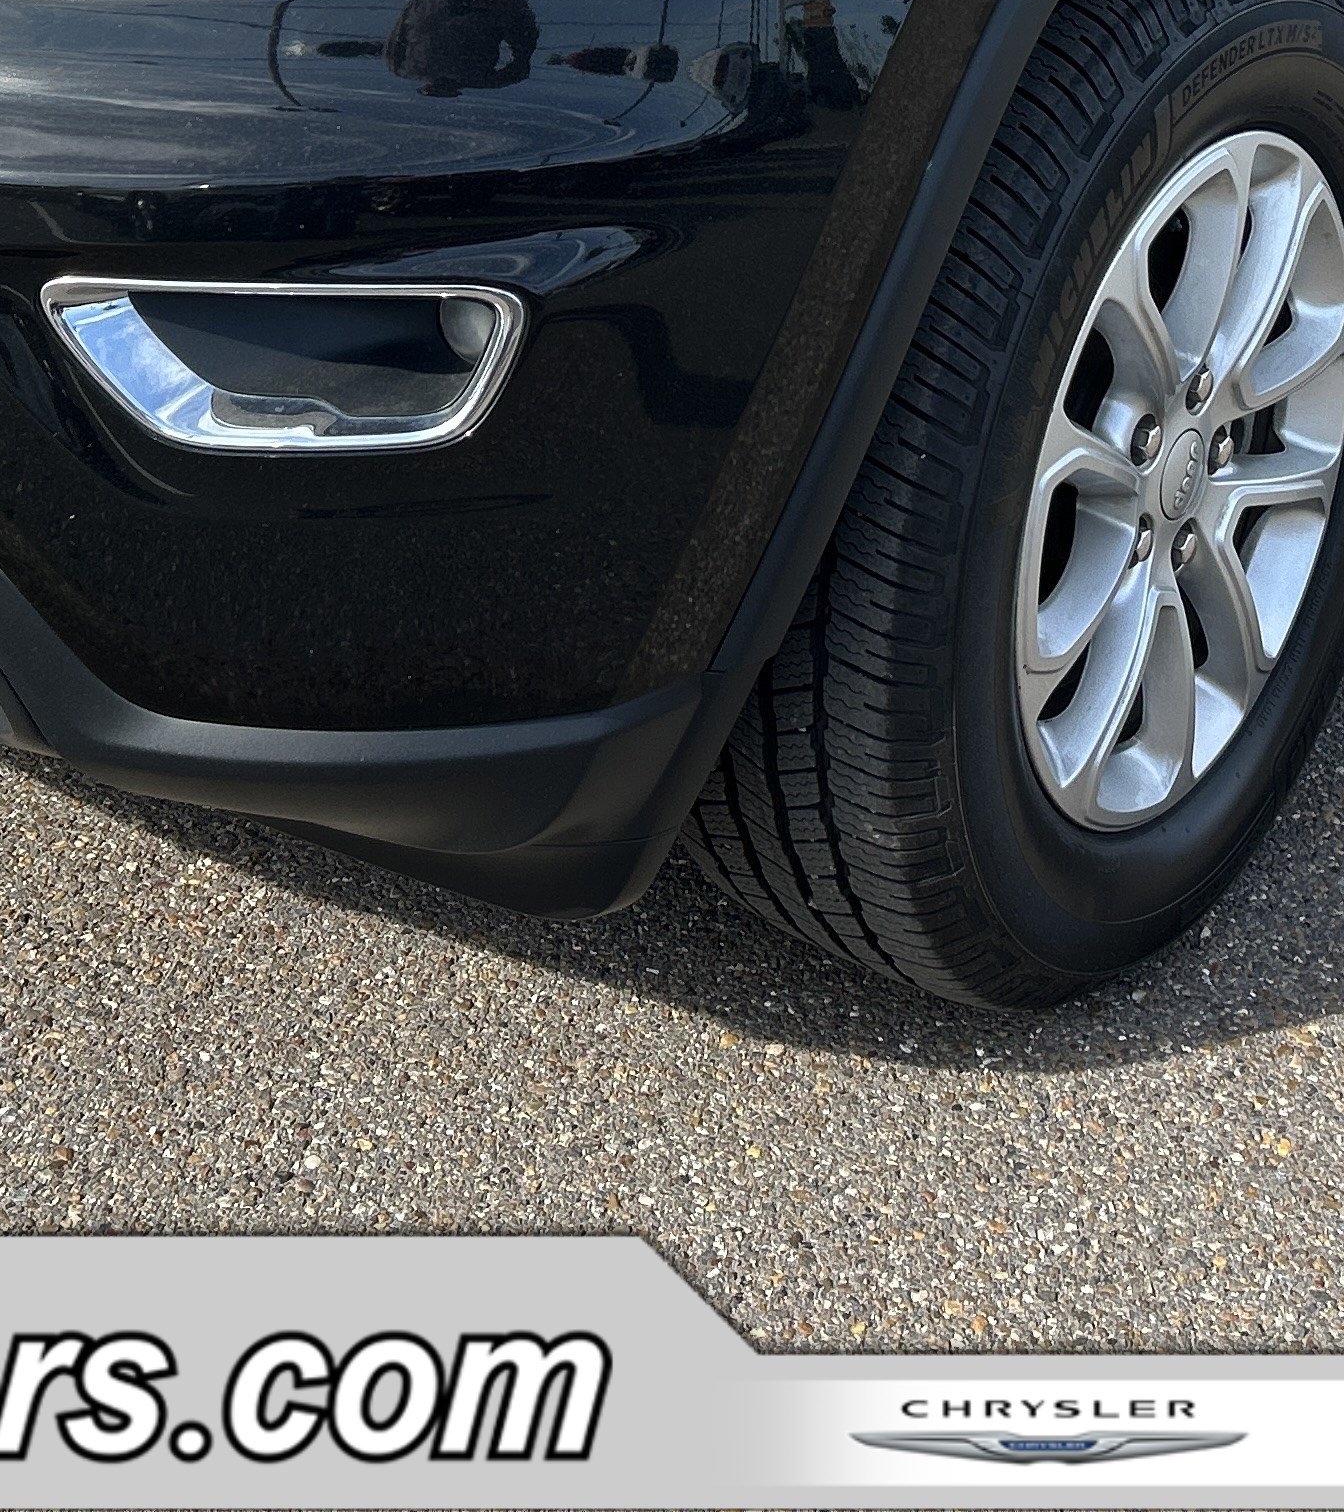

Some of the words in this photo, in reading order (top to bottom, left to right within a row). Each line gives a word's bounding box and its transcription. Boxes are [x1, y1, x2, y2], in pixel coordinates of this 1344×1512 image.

[1181, 33, 1256, 108] DEFENDER
[1257, 25, 1283, 51] LTX
[1031, 131, 1155, 400] MICHELIN
